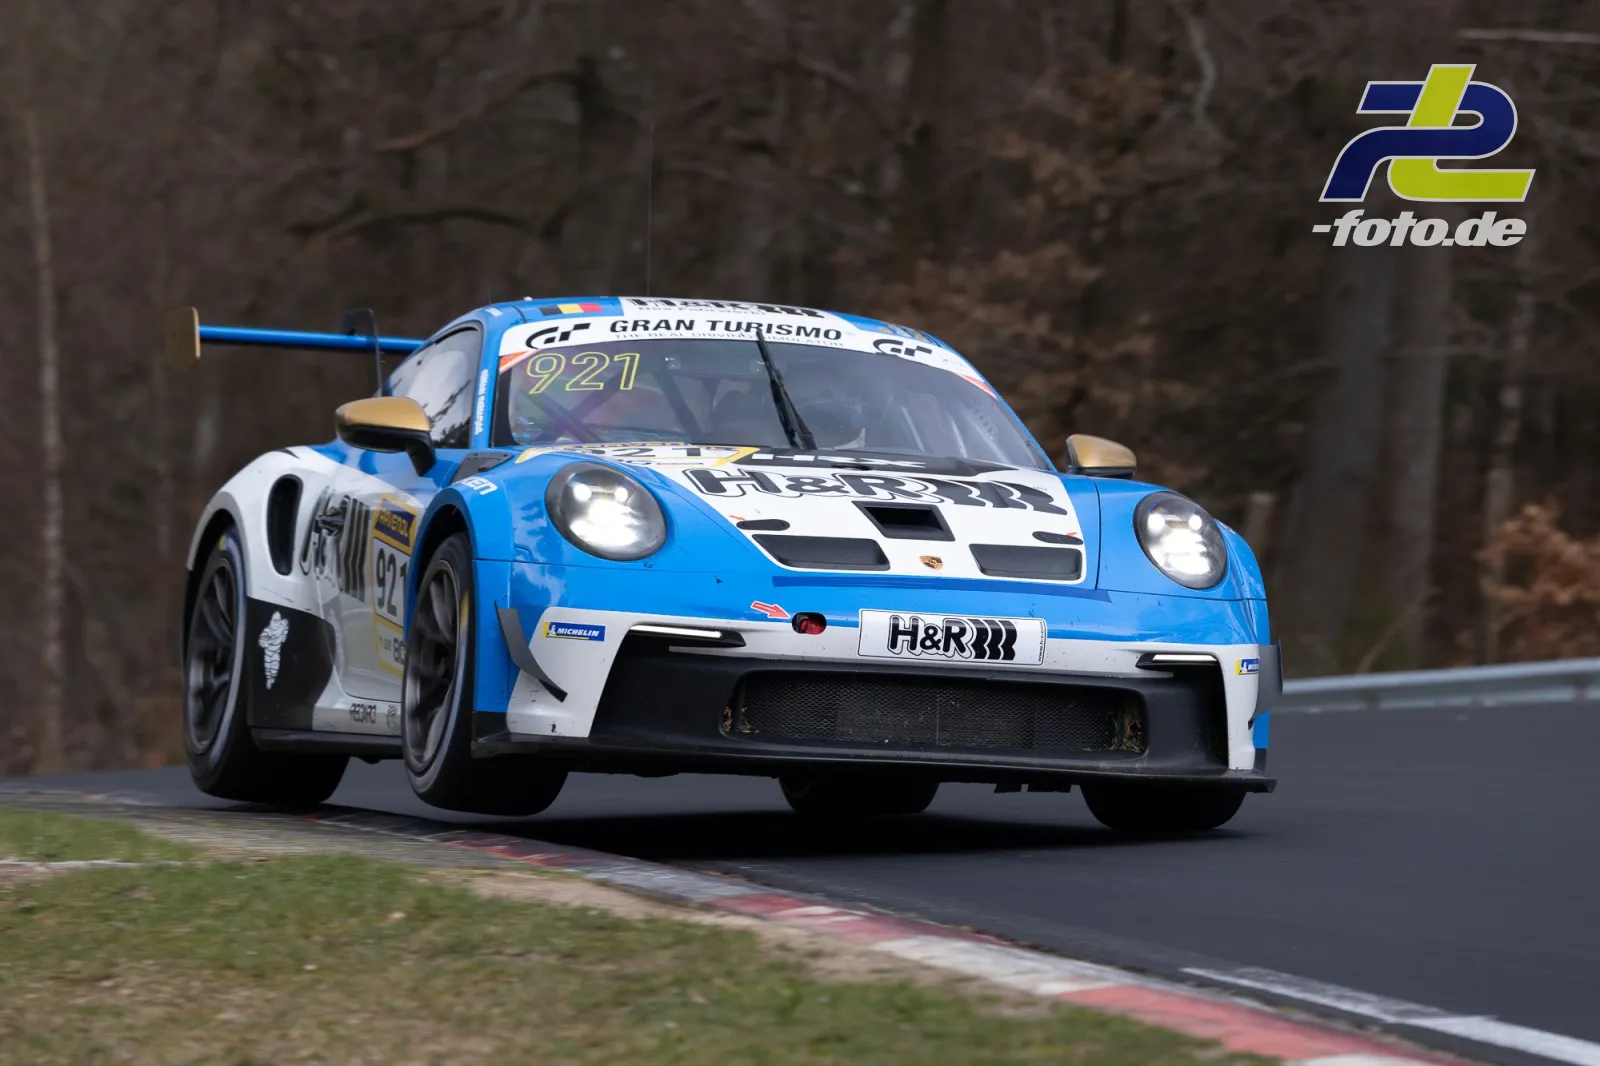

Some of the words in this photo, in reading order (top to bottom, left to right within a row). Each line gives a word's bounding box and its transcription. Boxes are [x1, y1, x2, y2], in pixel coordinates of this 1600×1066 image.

[610, 319, 695, 333] GRAN
[707, 320, 842, 341] TURISMO
[526, 351, 641, 395] 921
[682, 468, 946, 504] H&R
[557, 627, 600, 637] MICHELIN
[888, 615, 972, 659] H&R
